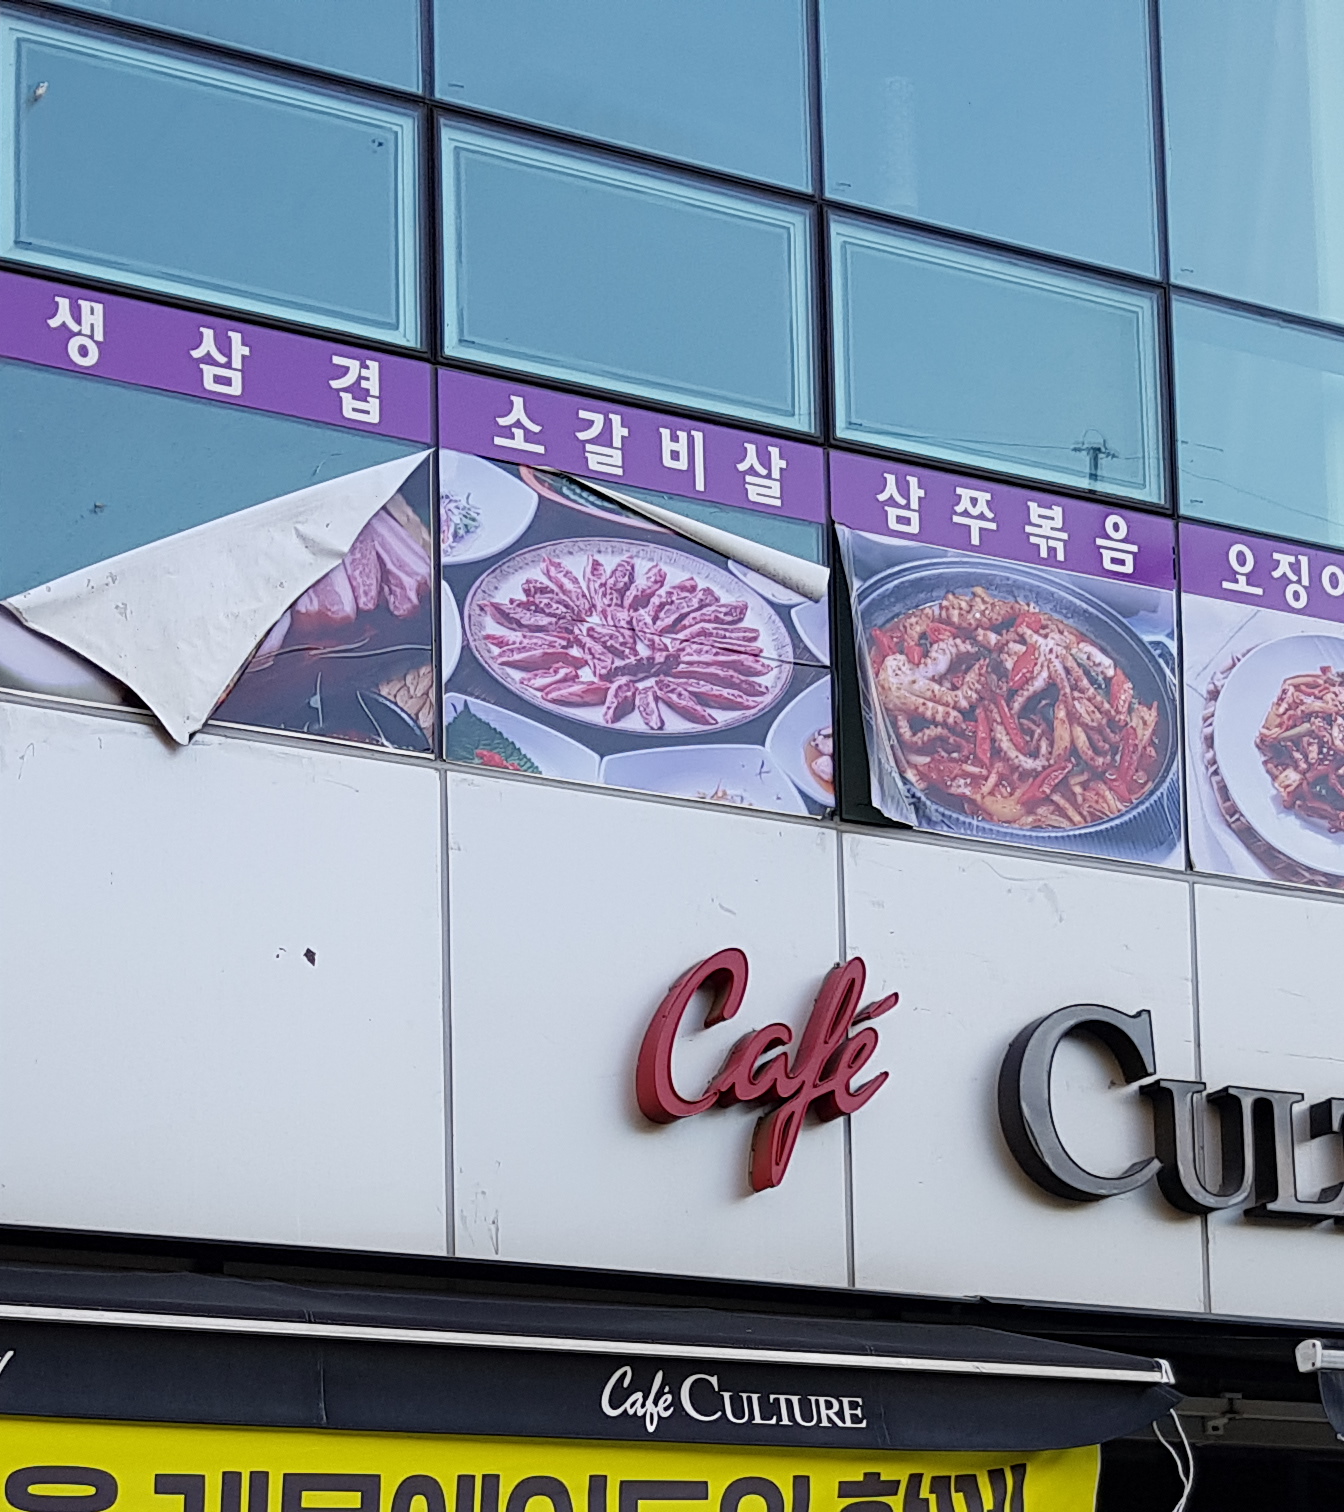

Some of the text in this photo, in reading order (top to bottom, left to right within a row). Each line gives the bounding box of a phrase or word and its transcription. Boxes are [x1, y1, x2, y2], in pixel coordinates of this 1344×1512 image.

[47, 295, 381, 425] 생삼겹
[493, 395, 787, 507] 소갈비살
[876, 473, 1139, 576] 삼쭈볶음
[635, 946, 900, 1194] Café
[600, 1365, 868, 1433] Café CULTURE
